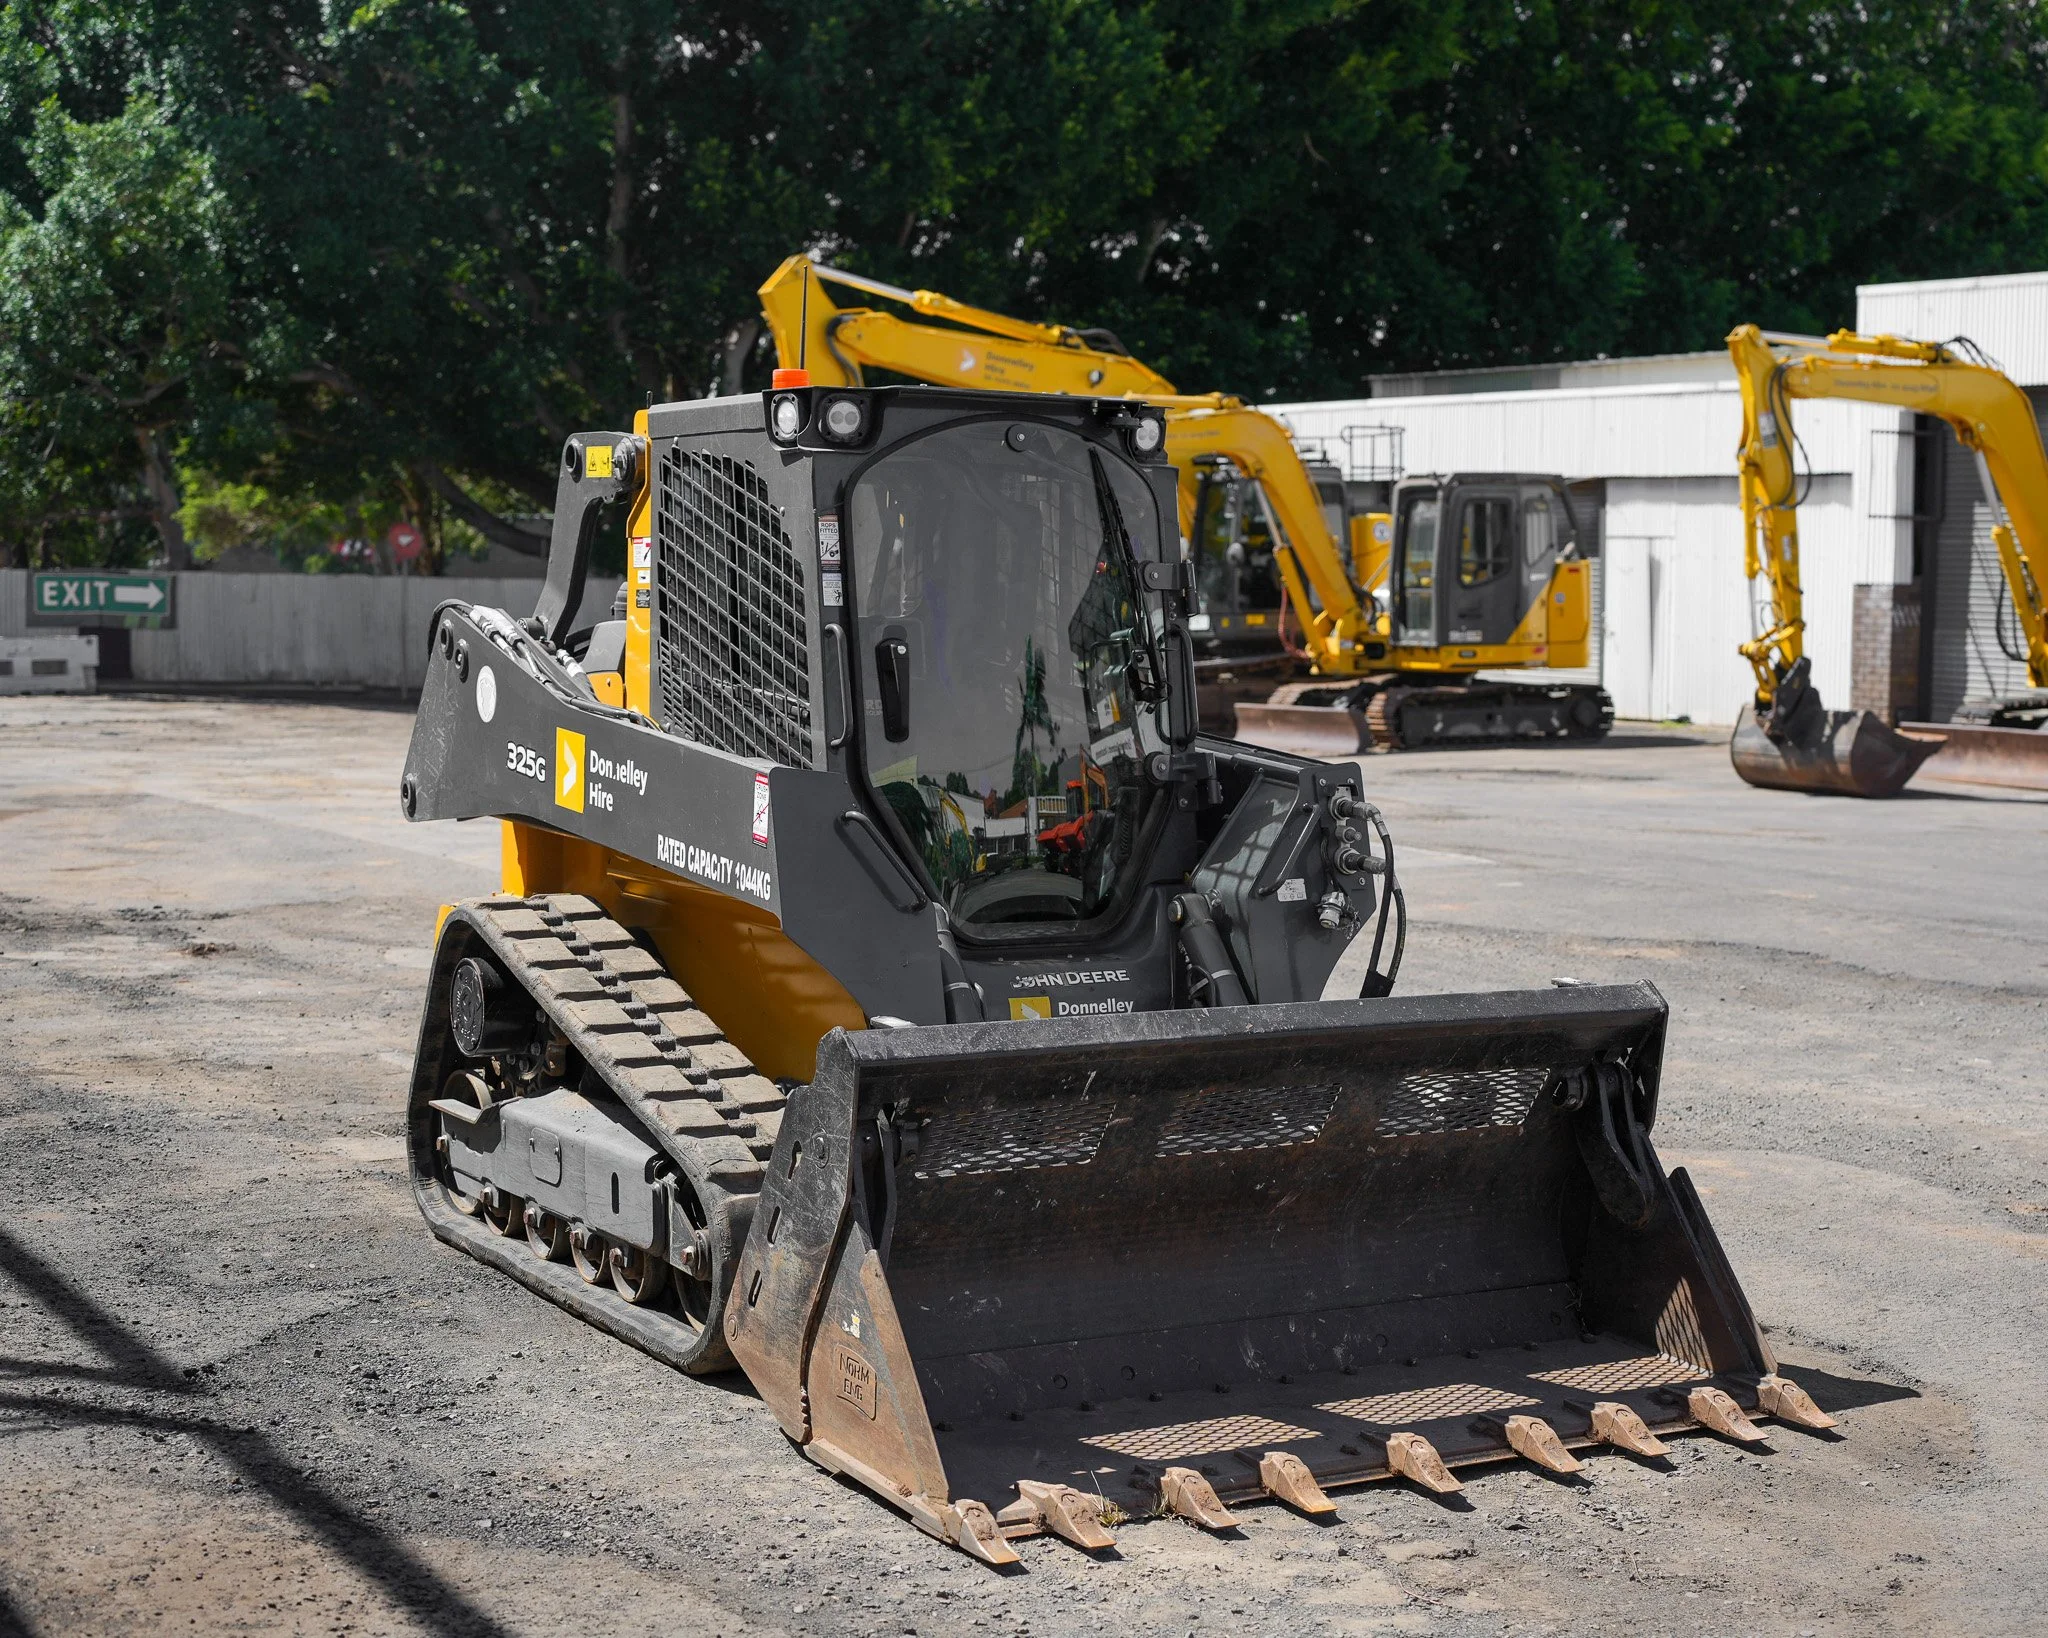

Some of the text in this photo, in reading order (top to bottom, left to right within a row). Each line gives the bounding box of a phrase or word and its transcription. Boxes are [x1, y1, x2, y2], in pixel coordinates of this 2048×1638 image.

[43, 581, 110, 606] EXIT
[507, 741, 546, 782] 325G
[589, 782, 614, 812] Hire
[657, 834, 771, 901] RATED CAPACITY 1044KG
[1011, 969, 1130, 988] JOHN DEERE
[1058, 998, 1134, 1016] Donnelley
